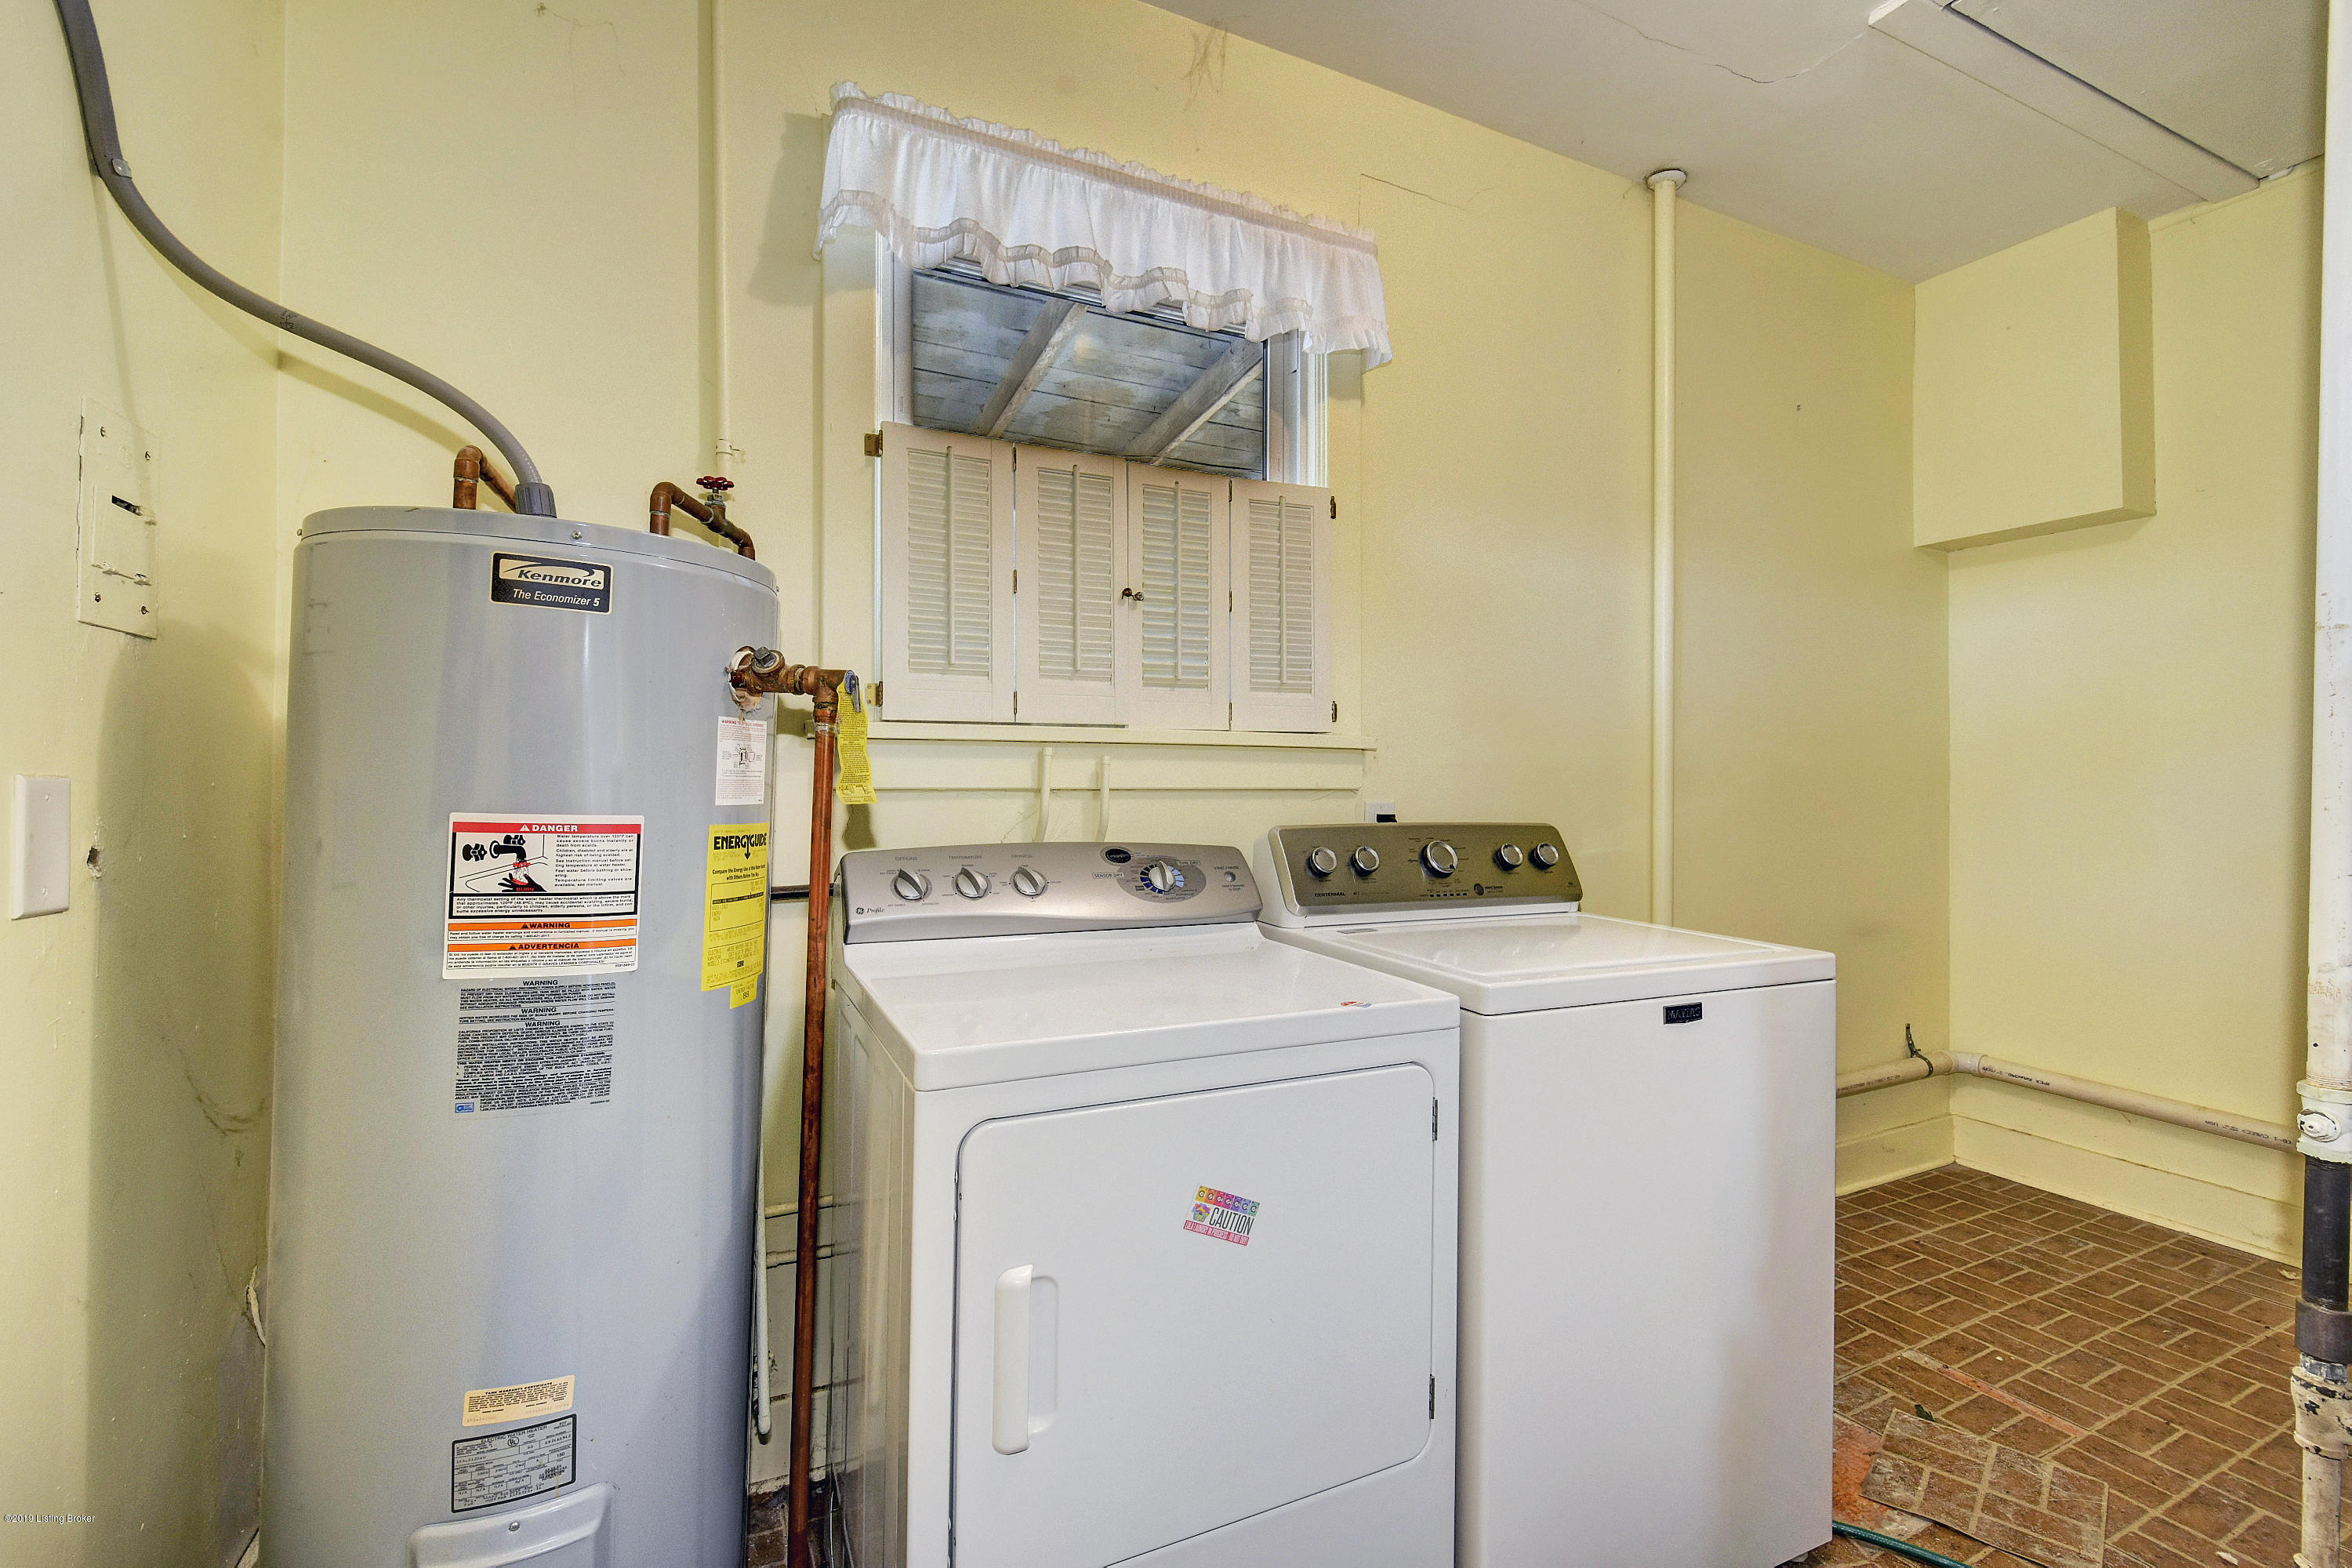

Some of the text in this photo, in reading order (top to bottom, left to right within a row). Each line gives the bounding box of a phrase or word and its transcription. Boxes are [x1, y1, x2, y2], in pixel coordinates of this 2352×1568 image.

[517, 570, 601, 587] Kenmore
[514, 589, 600, 607] The Economizer 5
[713, 833, 767, 850] ENERGYGUIDE
[1209, 1207, 1254, 1236] CAUTION
